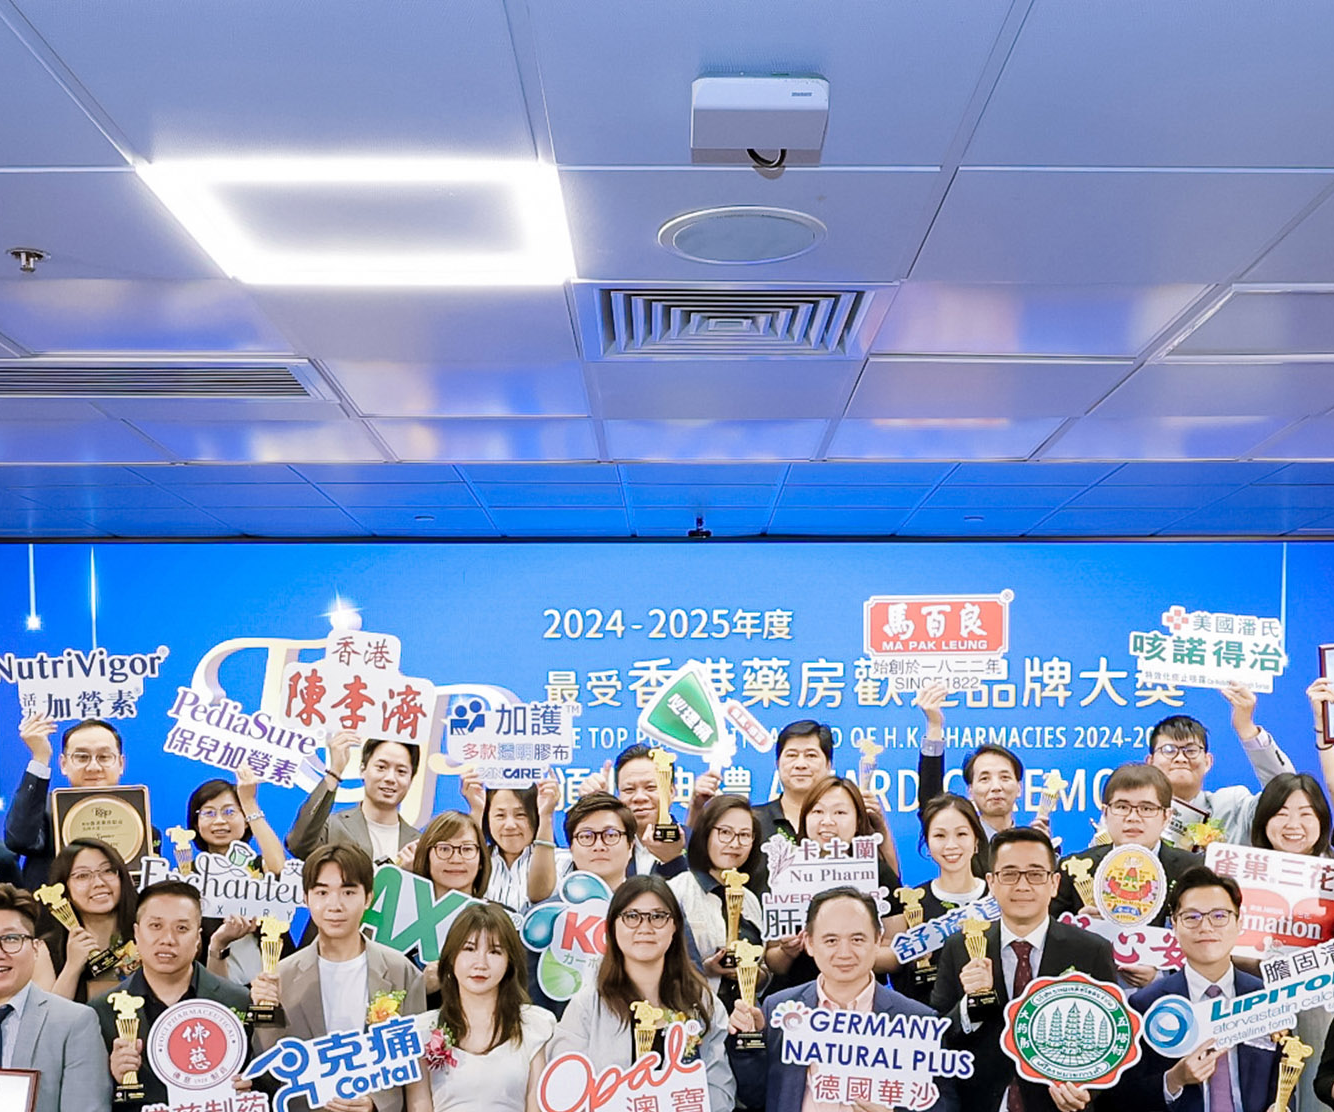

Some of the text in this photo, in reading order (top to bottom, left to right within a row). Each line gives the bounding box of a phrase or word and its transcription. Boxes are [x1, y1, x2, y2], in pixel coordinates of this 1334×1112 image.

[882, 602, 988, 640] 馬百良
[1192, 614, 1279, 638] 美國潘氏
[332, 635, 394, 670] 香港
[882, 639, 988, 651] MA PAK LEUNG
[1132, 633, 1283, 673] 咳諾得治
[873, 658, 1000, 675] 始創於一八二二年
[42, 689, 136, 720] 加營素
[285, 668, 429, 740] 陳李濟
[495, 703, 563, 736] 加護
[171, 688, 318, 756] PediaSure
[587, 728, 624, 749] TOP
[942, 726, 1067, 748] HARMACIES
[1073, 726, 1154, 748] 2024-20
[166, 725, 299, 786] 保兒加營素
[799, 837, 875, 860] 卡士蘭
[789, 867, 875, 883] Nu Pharm
[810, 1009, 951, 1042] GERMANY
[1212, 1000, 1298, 1036] atorvastatin
[313, 1017, 422, 1079] 克痛
[784, 1042, 975, 1077] NATURAL PLUS
[812, 1074, 941, 1109] 德國華沙
